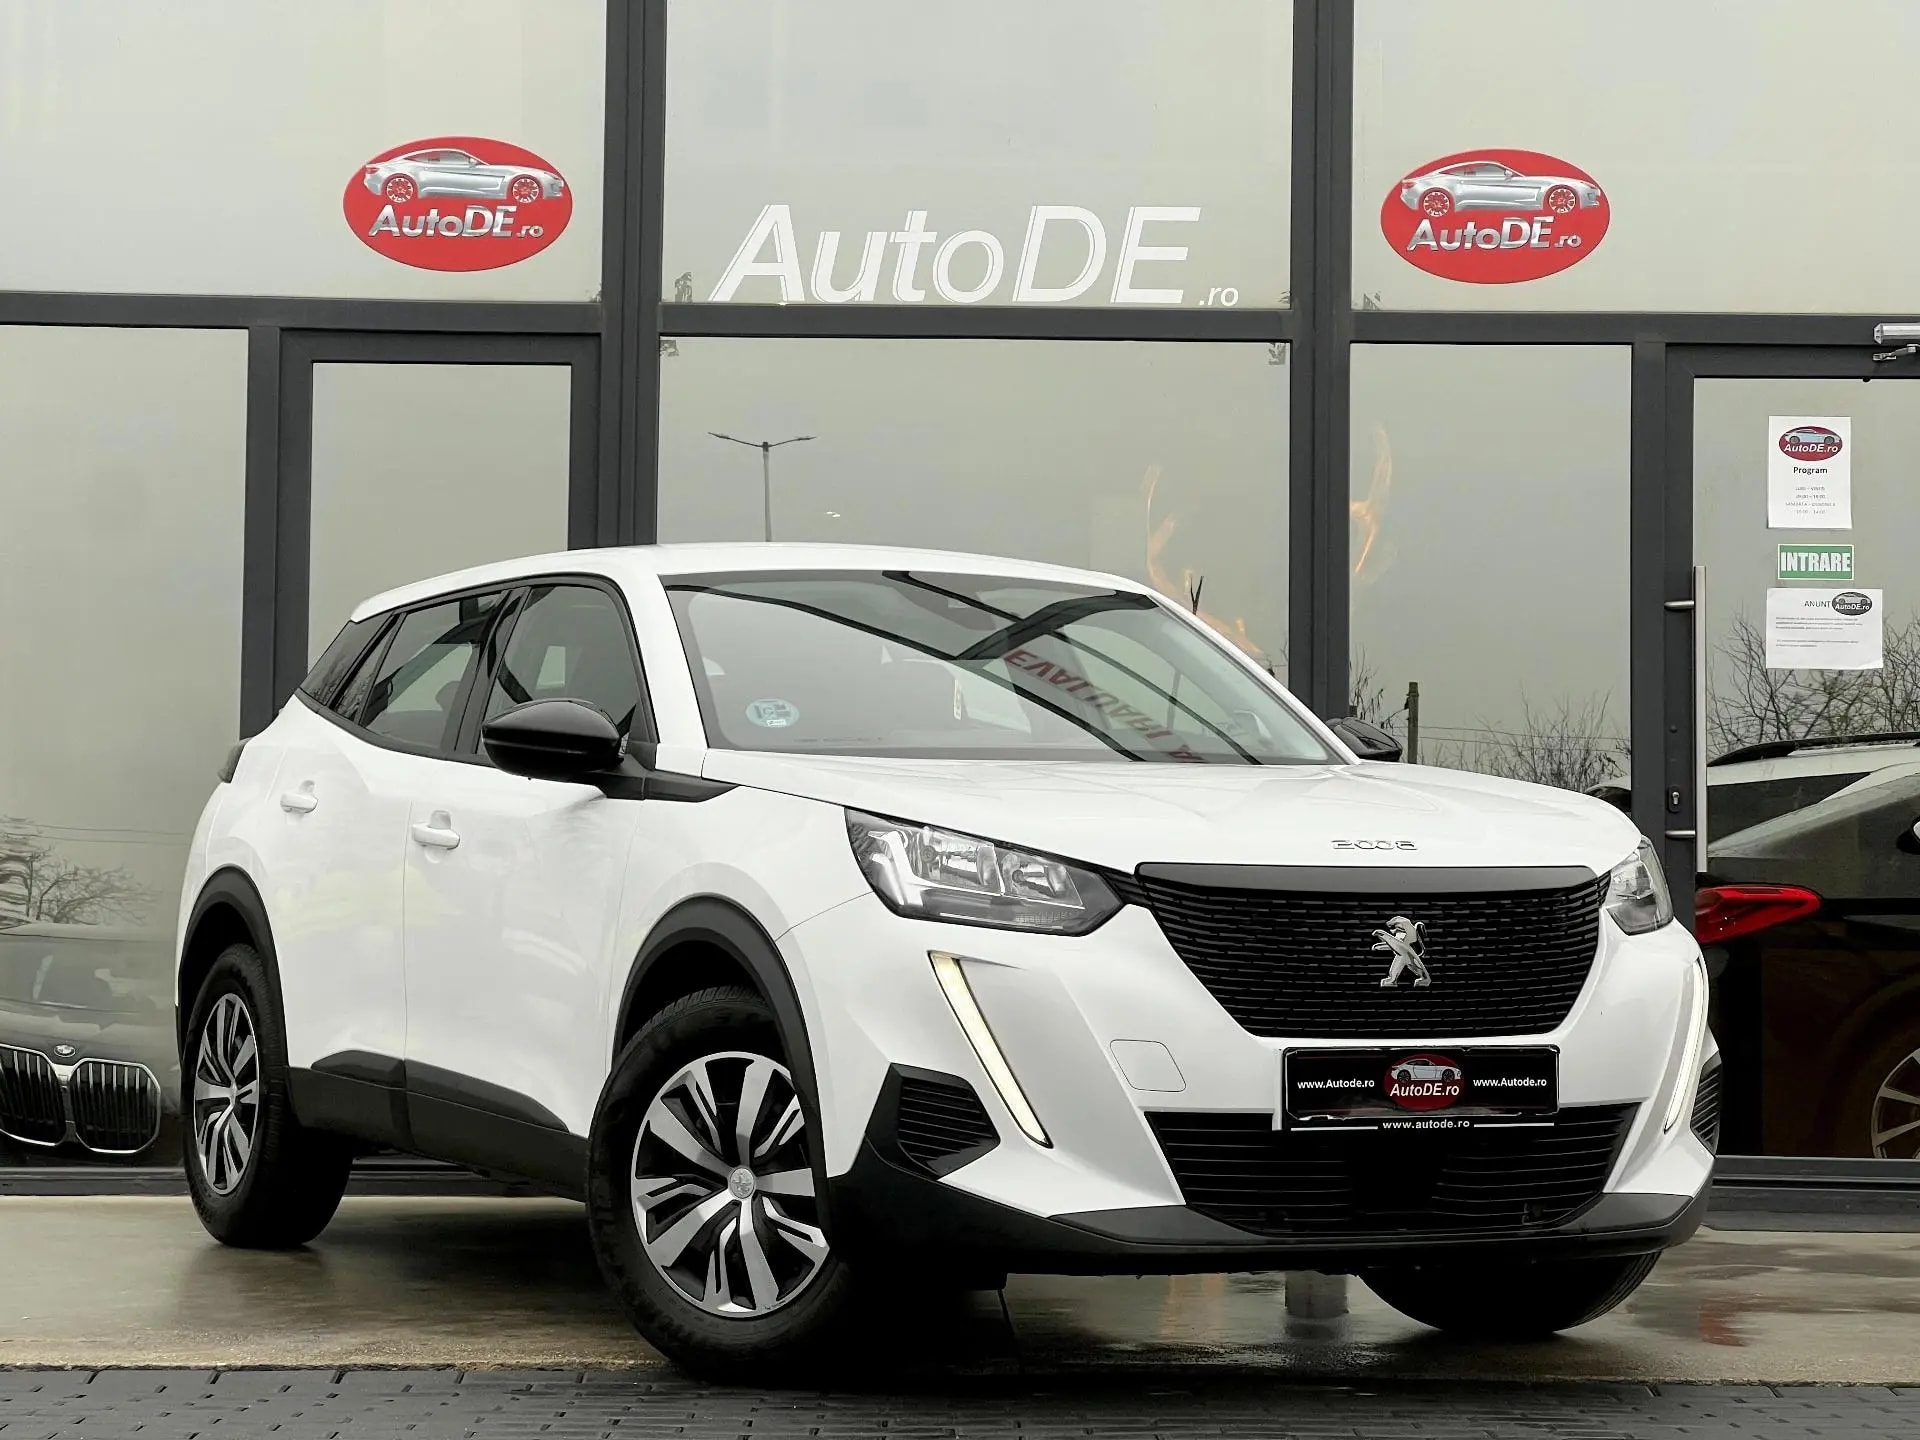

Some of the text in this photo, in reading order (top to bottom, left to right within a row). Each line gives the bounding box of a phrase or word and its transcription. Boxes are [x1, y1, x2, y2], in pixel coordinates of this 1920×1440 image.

[1784, 443, 1839, 453] AutoDE.ro
[1793, 466, 1828, 475] Program
[1780, 551, 1852, 572] INTRARE
[1297, 1078, 1375, 1089] www.Autode.ro
[1473, 1077, 1548, 1088] www.Autode.ro
[1390, 1083, 1460, 1097] AutoDE.ro
[1382, 1119, 1471, 1130] www.autode.ro
